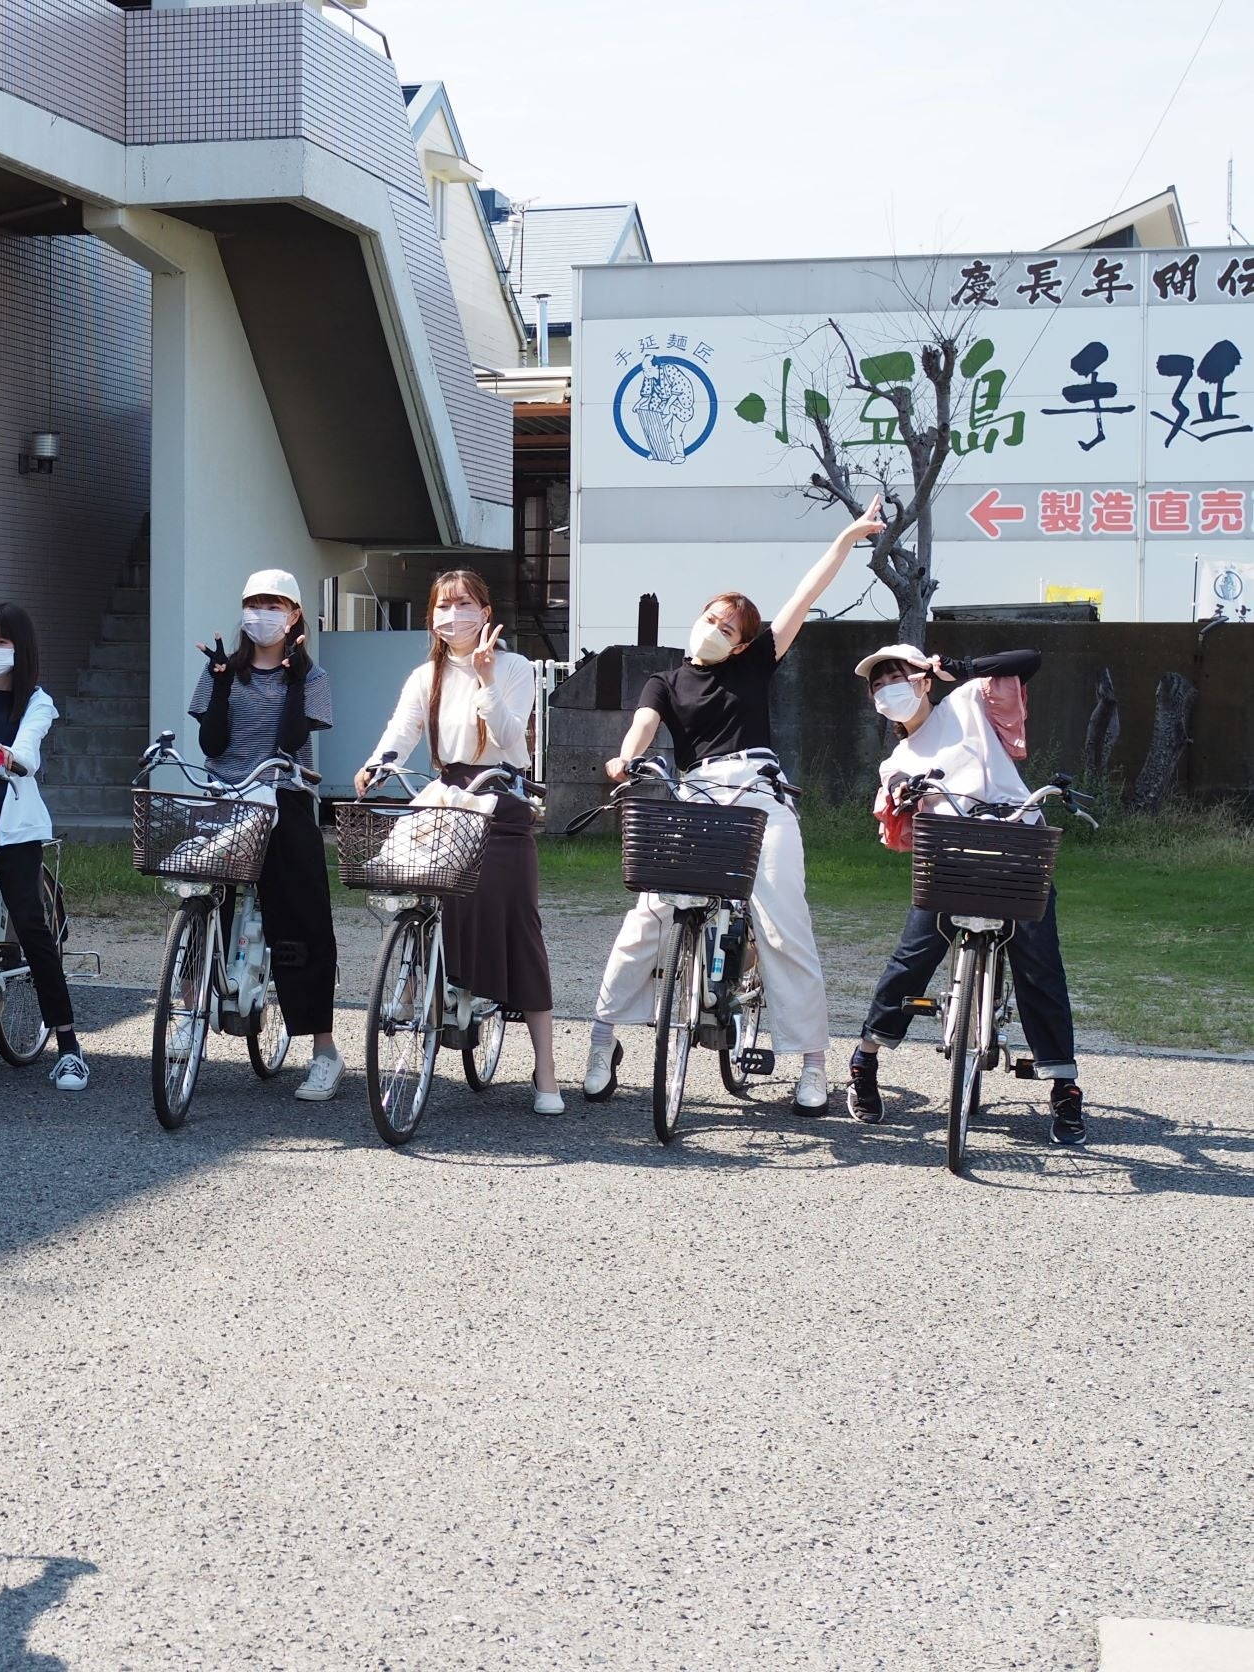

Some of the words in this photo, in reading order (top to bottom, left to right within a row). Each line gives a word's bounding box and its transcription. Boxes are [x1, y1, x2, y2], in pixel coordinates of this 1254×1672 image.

[614, 333, 715, 367] 手延麺匠
[1040, 490, 1245, 533] 製造直売
